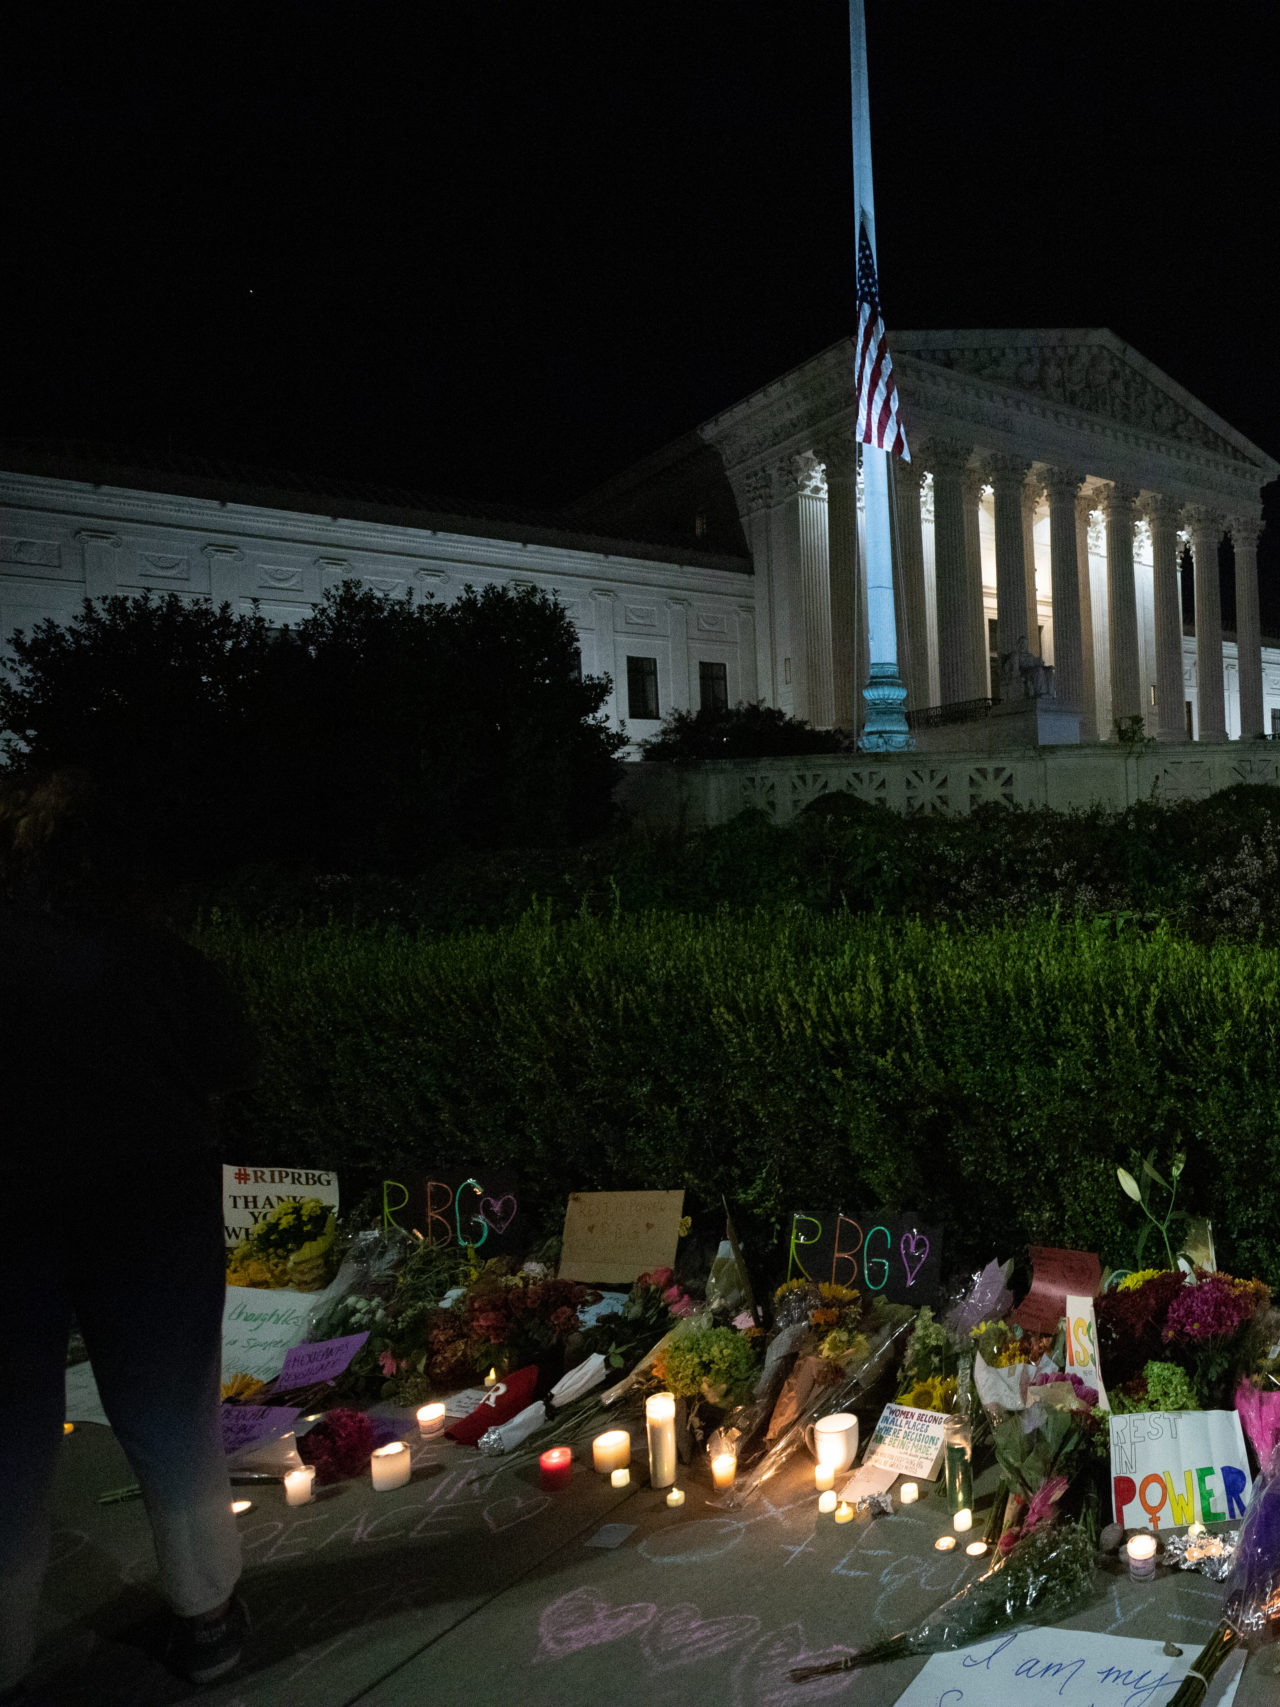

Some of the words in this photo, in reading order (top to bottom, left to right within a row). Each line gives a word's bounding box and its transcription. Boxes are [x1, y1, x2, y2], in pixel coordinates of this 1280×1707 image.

[233, 1167, 333, 1187] #RIPRBG
[889, 1416, 903, 1428] ALL
[904, 1420, 929, 1433] PLACES
[916, 1412, 943, 1425] BELONG
[1110, 1412, 1183, 1446] REST
[877, 1425, 902, 1438] WHERE
[903, 1430, 940, 1446] DECISIONS
[1114, 1443, 1137, 1475] IN
[1113, 1465, 1247, 1531] POWER
[961, 1632, 1019, 1670] I
[1013, 1656, 1086, 1697] am
[1095, 1665, 1184, 1707] my
